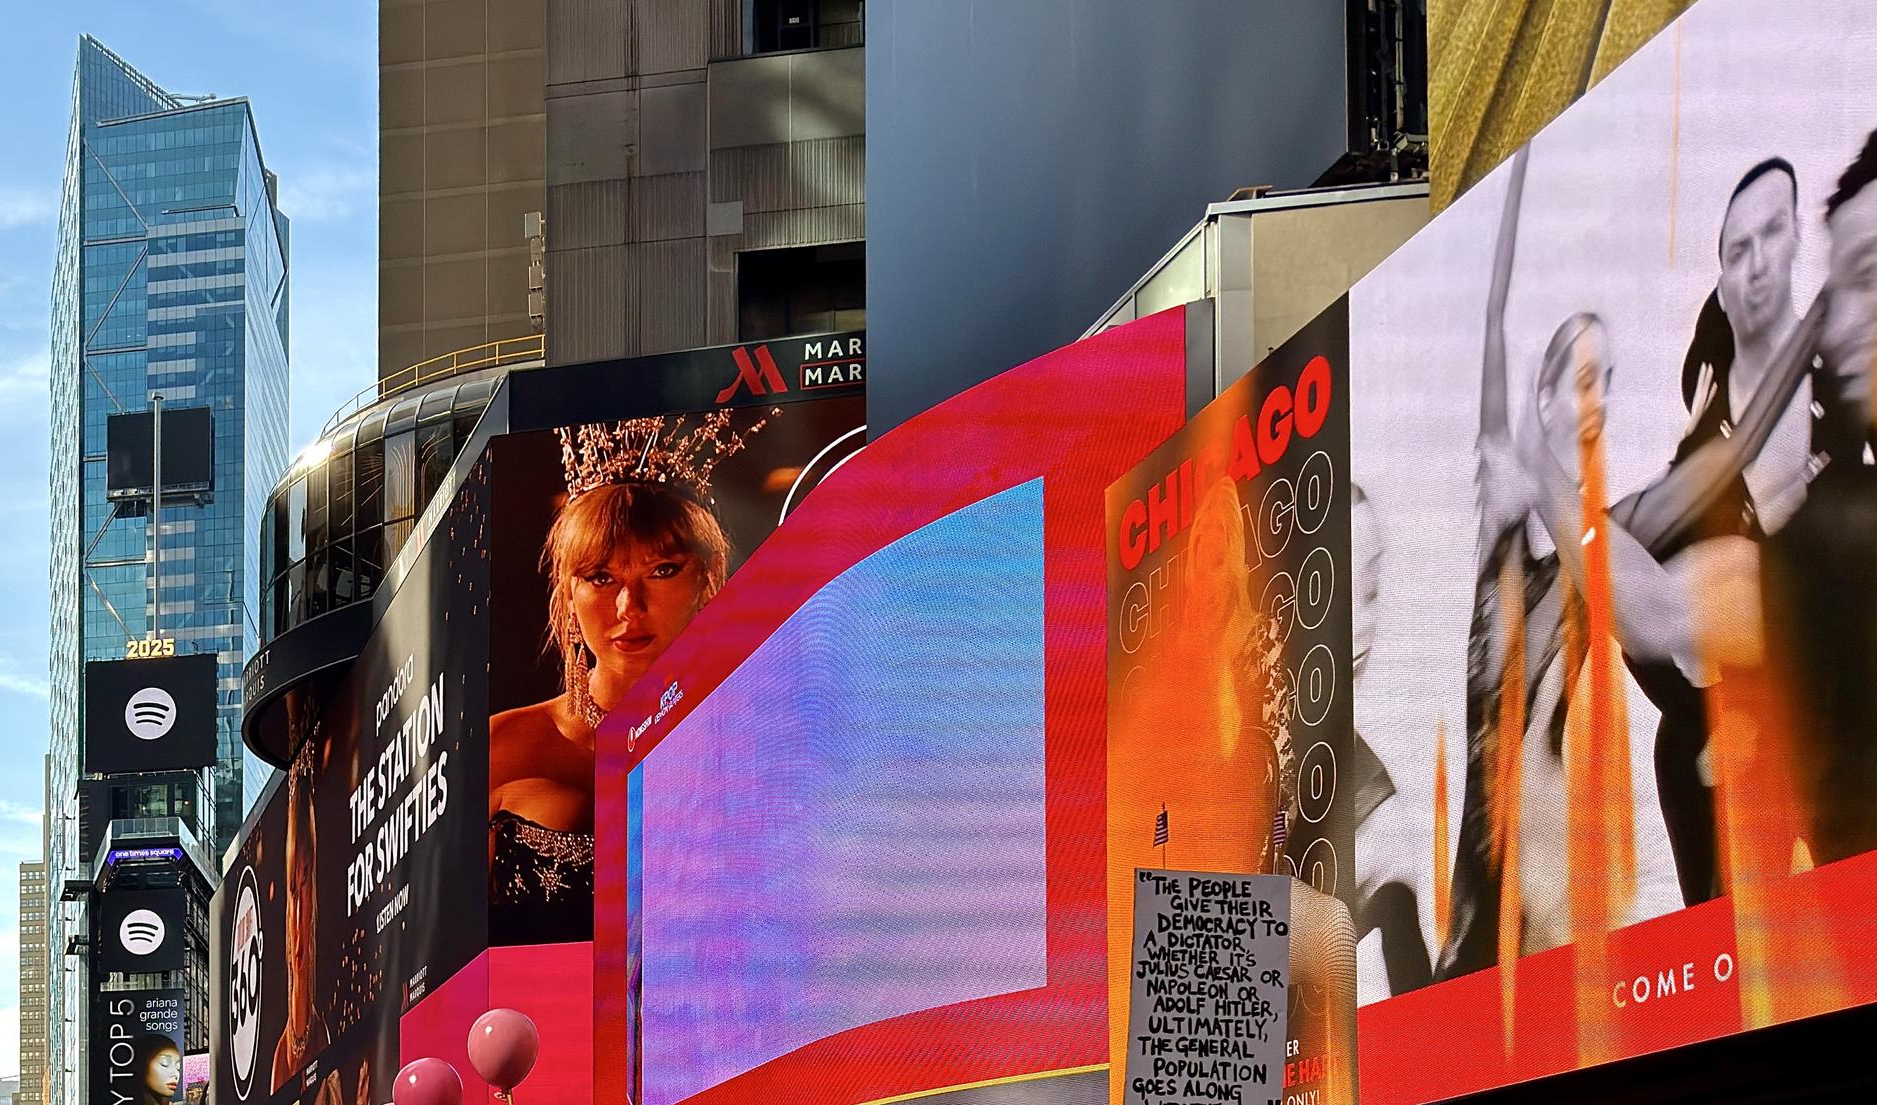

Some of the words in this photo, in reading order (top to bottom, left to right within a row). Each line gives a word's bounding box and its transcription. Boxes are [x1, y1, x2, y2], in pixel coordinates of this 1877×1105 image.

[127, 638, 175, 658] 2025
[375, 654, 414, 737] pandora
[349, 776, 375, 845] THE
[377, 672, 444, 801] STATION
[347, 850, 374, 917] FOR
[376, 750, 449, 885] SWIFTIES
[1189, 877, 1252, 898] PEOPLE
[376, 901, 395, 935] LISTEN
[395, 884, 409, 915] NOW
[1171, 895, 1211, 913] GIVE
[1215, 900, 1273, 918] THEIR
[1157, 913, 1258, 939] DEMOCRACY
[1261, 920, 1288, 936] TO
[1143, 930, 1156, 948] A
[1168, 932, 1250, 954] DICTATOR,
[1147, 946, 1219, 965] WHETHER
[1230, 952, 1256, 967] IT'S
[1136, 960, 1189, 979] JULIUS
[1194, 964, 1252, 983] CAESAR
[1261, 970, 1284, 988] OR
[1613, 962, 1695, 1008] COME
[1714, 952, 1733, 982] O
[1146, 976, 1229, 999] NAPOLEON
[1238, 987, 1260, 1001] OR
[110, 999, 135, 1016] 5
[139, 1010, 178, 1021] grande
[146, 998, 178, 1008] ariana
[1153, 995, 1205, 1014] ADOLF
[1215, 1000, 1278, 1022] HITLER,
[146, 1022, 178, 1032] songs
[1148, 1016, 1268, 1042] ULTIMATELY,
[110, 1023, 134, 1084] TOP
[1137, 1036, 1172, 1055] THE
[1175, 1036, 1255, 1060] GENERAL
[1153, 1058, 1267, 1084] POPULATION
[1132, 1077, 1176, 1100] GOES
[1183, 1080, 1242, 1105] ALONG
